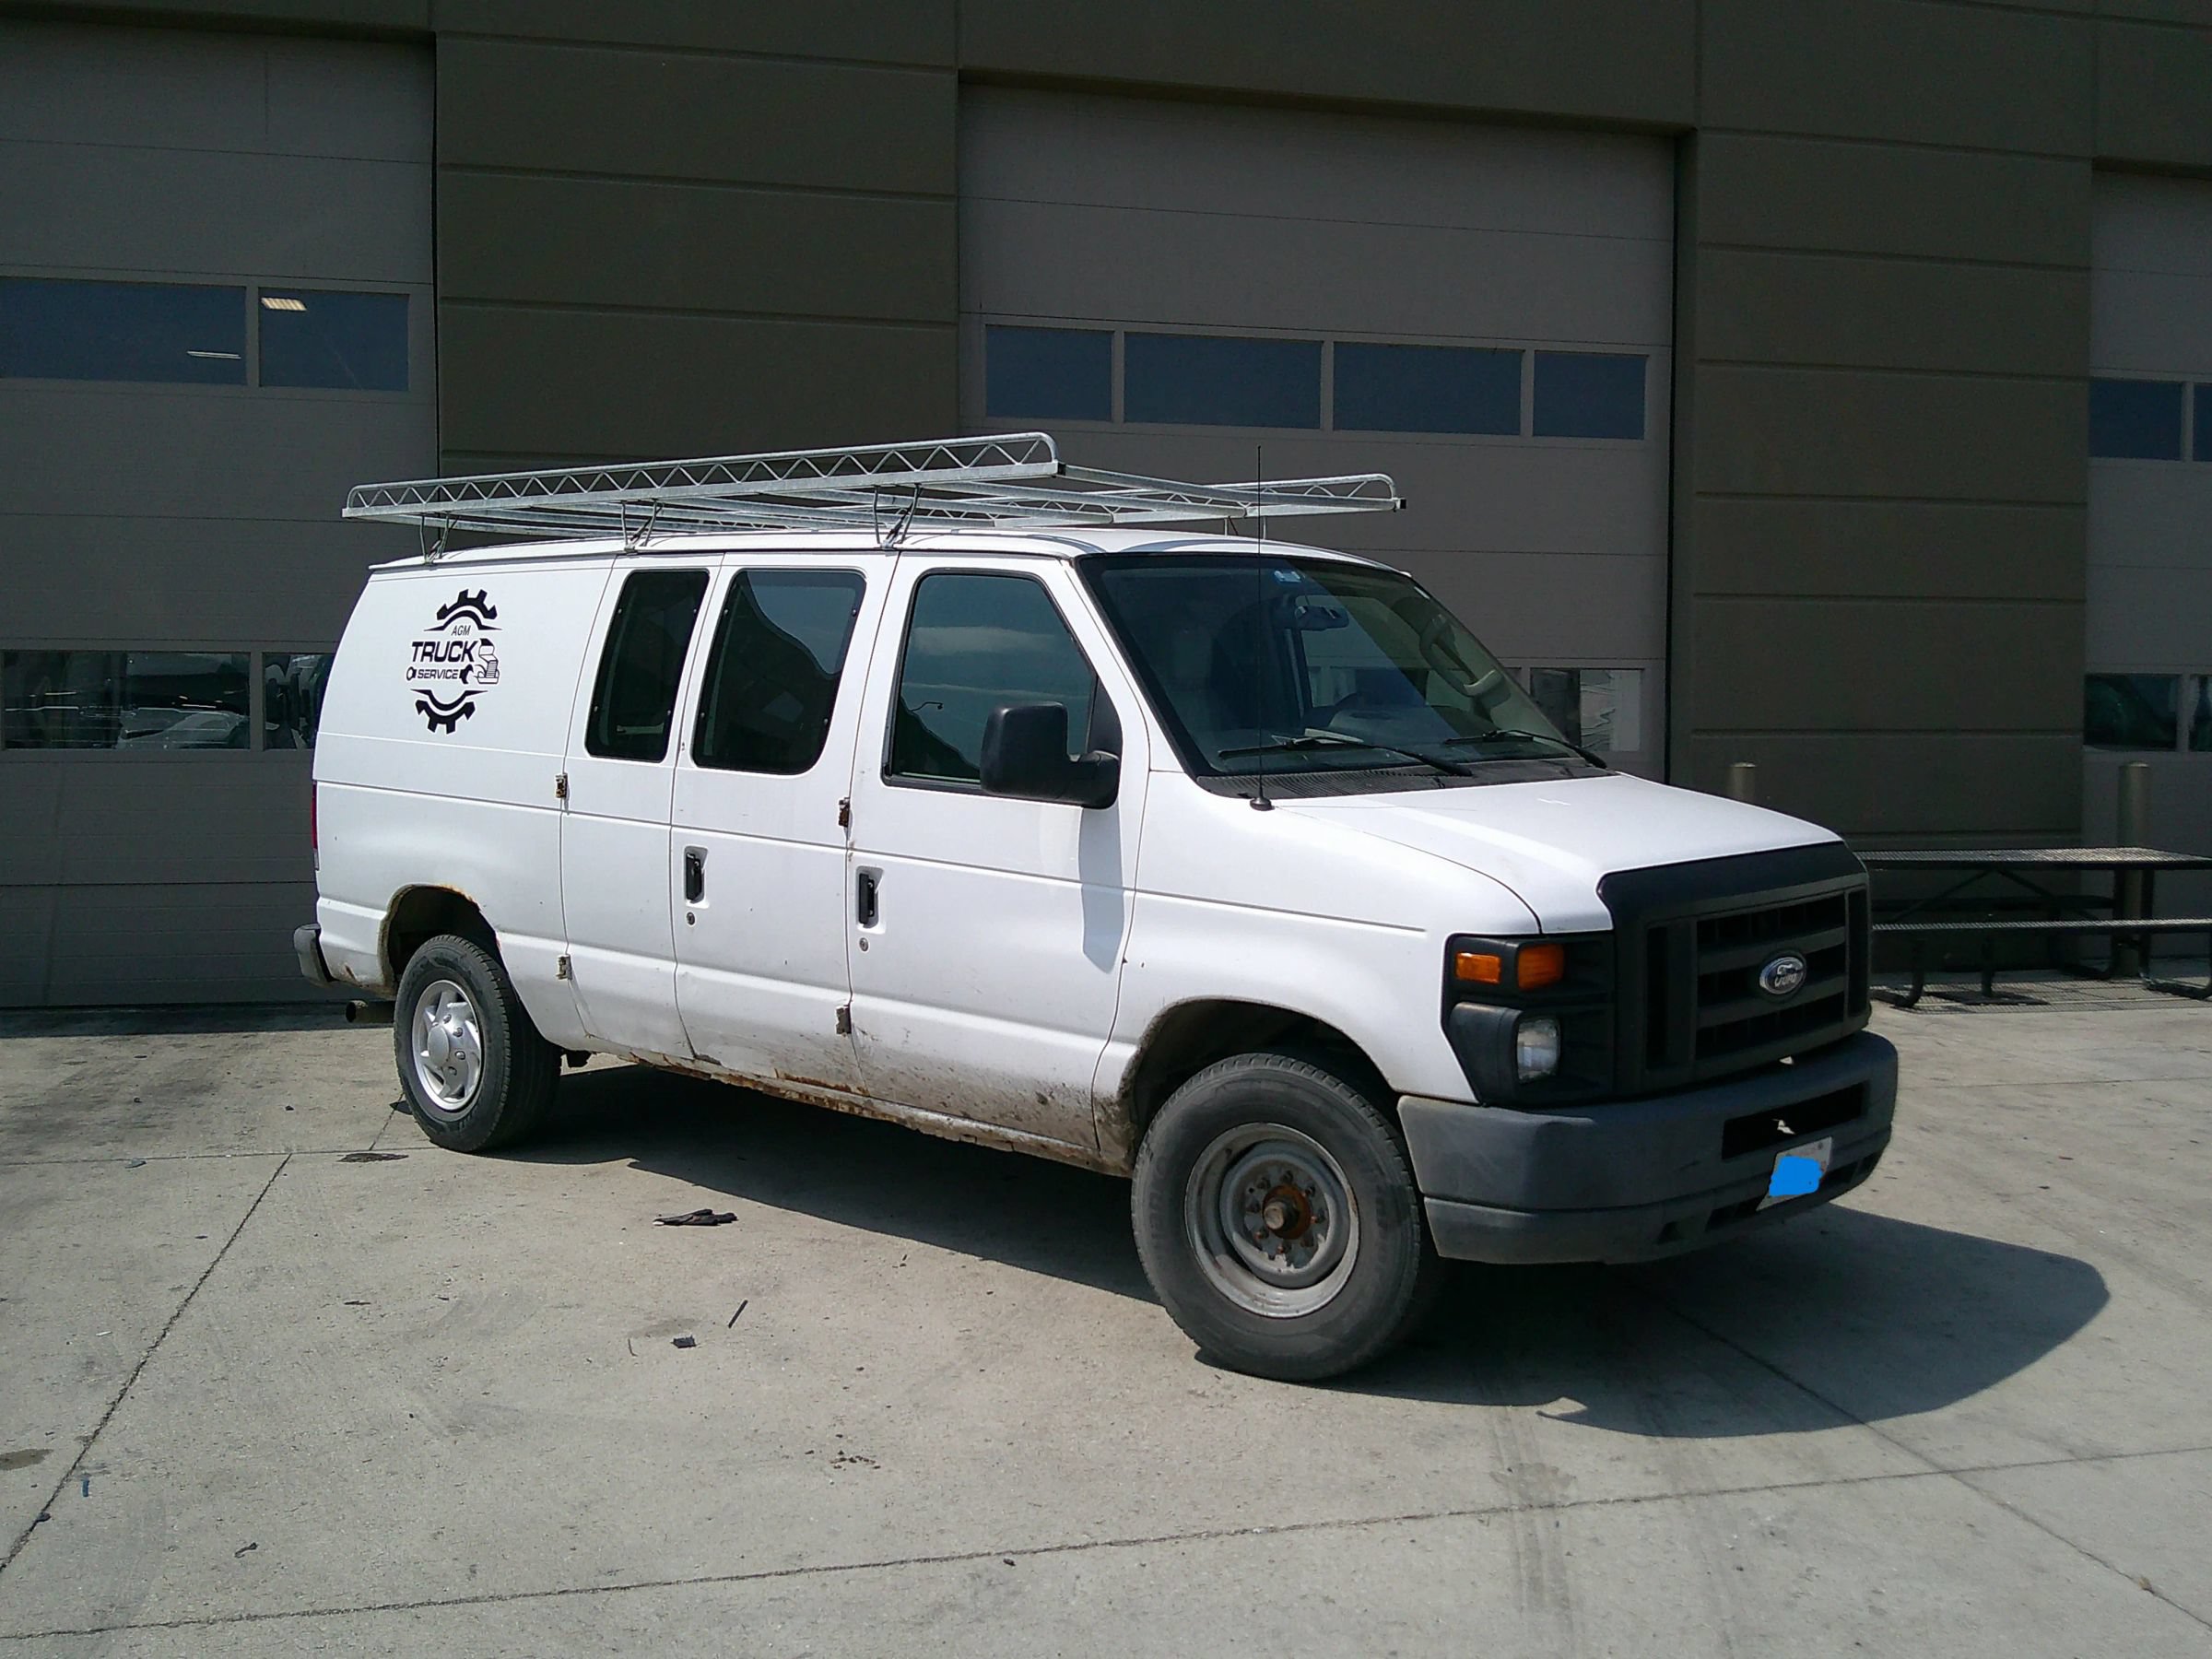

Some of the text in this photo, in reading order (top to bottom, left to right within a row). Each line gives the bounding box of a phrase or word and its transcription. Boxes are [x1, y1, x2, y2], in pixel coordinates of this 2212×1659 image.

[451, 625, 471, 636] AGM
[412, 641, 478, 662] TRUCK
[417, 669, 459, 679] SERVICE
